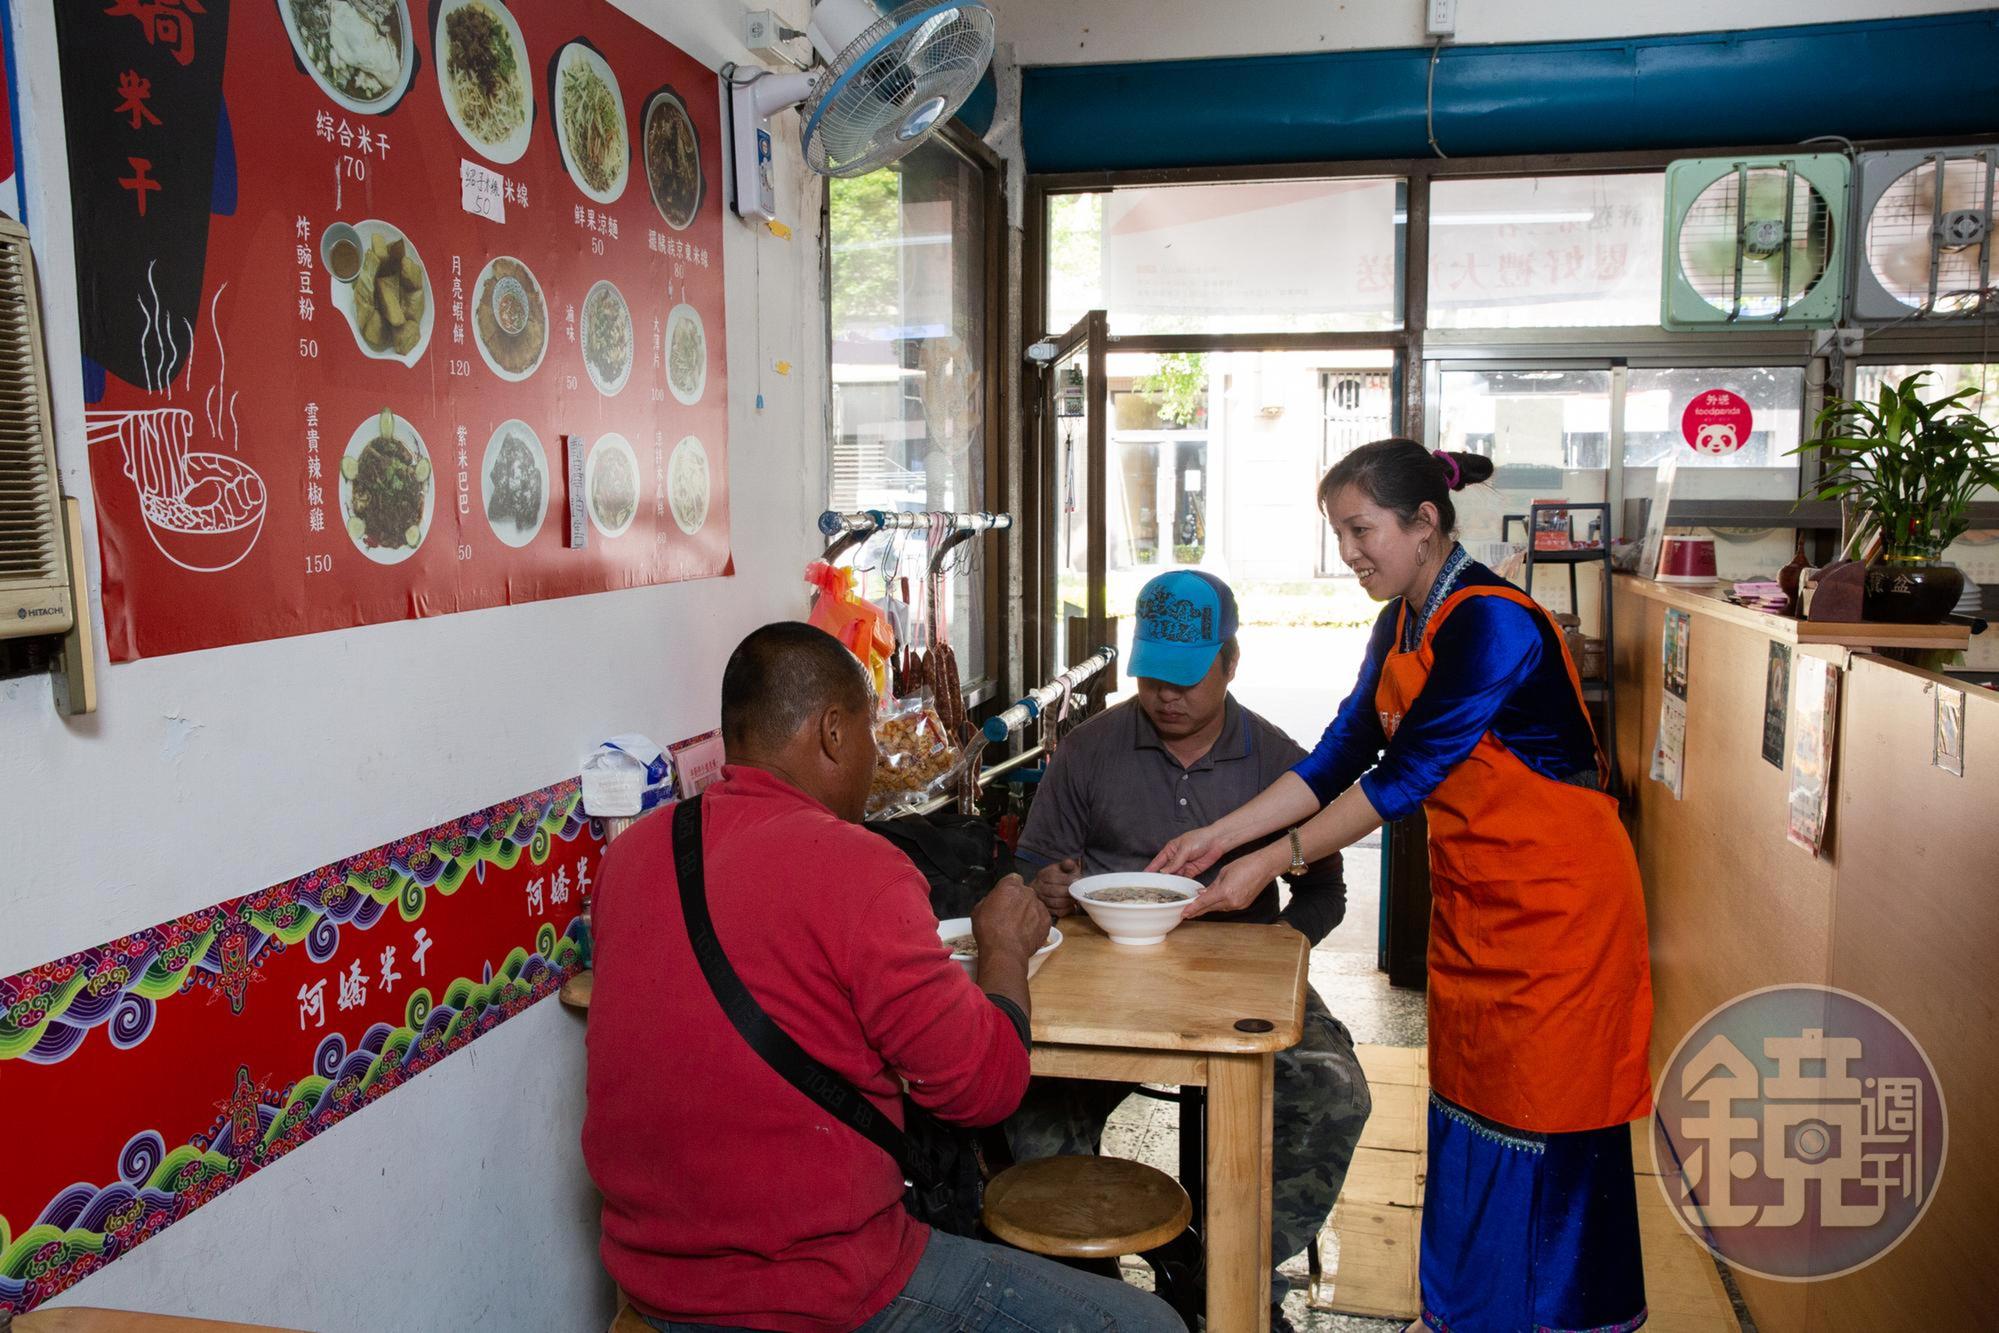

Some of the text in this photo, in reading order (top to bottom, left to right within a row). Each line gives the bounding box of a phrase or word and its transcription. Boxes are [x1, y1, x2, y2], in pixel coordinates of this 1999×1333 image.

[316, 109, 391, 160] 綜合米干
[343, 154, 365, 181] 70
[505, 176, 530, 208] 米線
[473, 194, 491, 215] 50
[591, 236, 605, 256] 50
[295, 215, 315, 321] 炸豌豆粉
[451, 255, 465, 345] 月亮蝦餅
[299, 339, 318, 358] 50
[449, 359, 471, 377] 120
[565, 375, 578, 391] 50
[1695, 407, 1741, 416] foodpanda
[304, 402, 325, 532] 雲貴辣椒雞
[456, 425, 470, 514] 紫米巴巴
[458, 544, 473, 560] 50
[305, 554, 333, 574] 150
[28, 607, 64, 617] HITACHI
[297, 927, 433, 1031] 阿嬌米干
